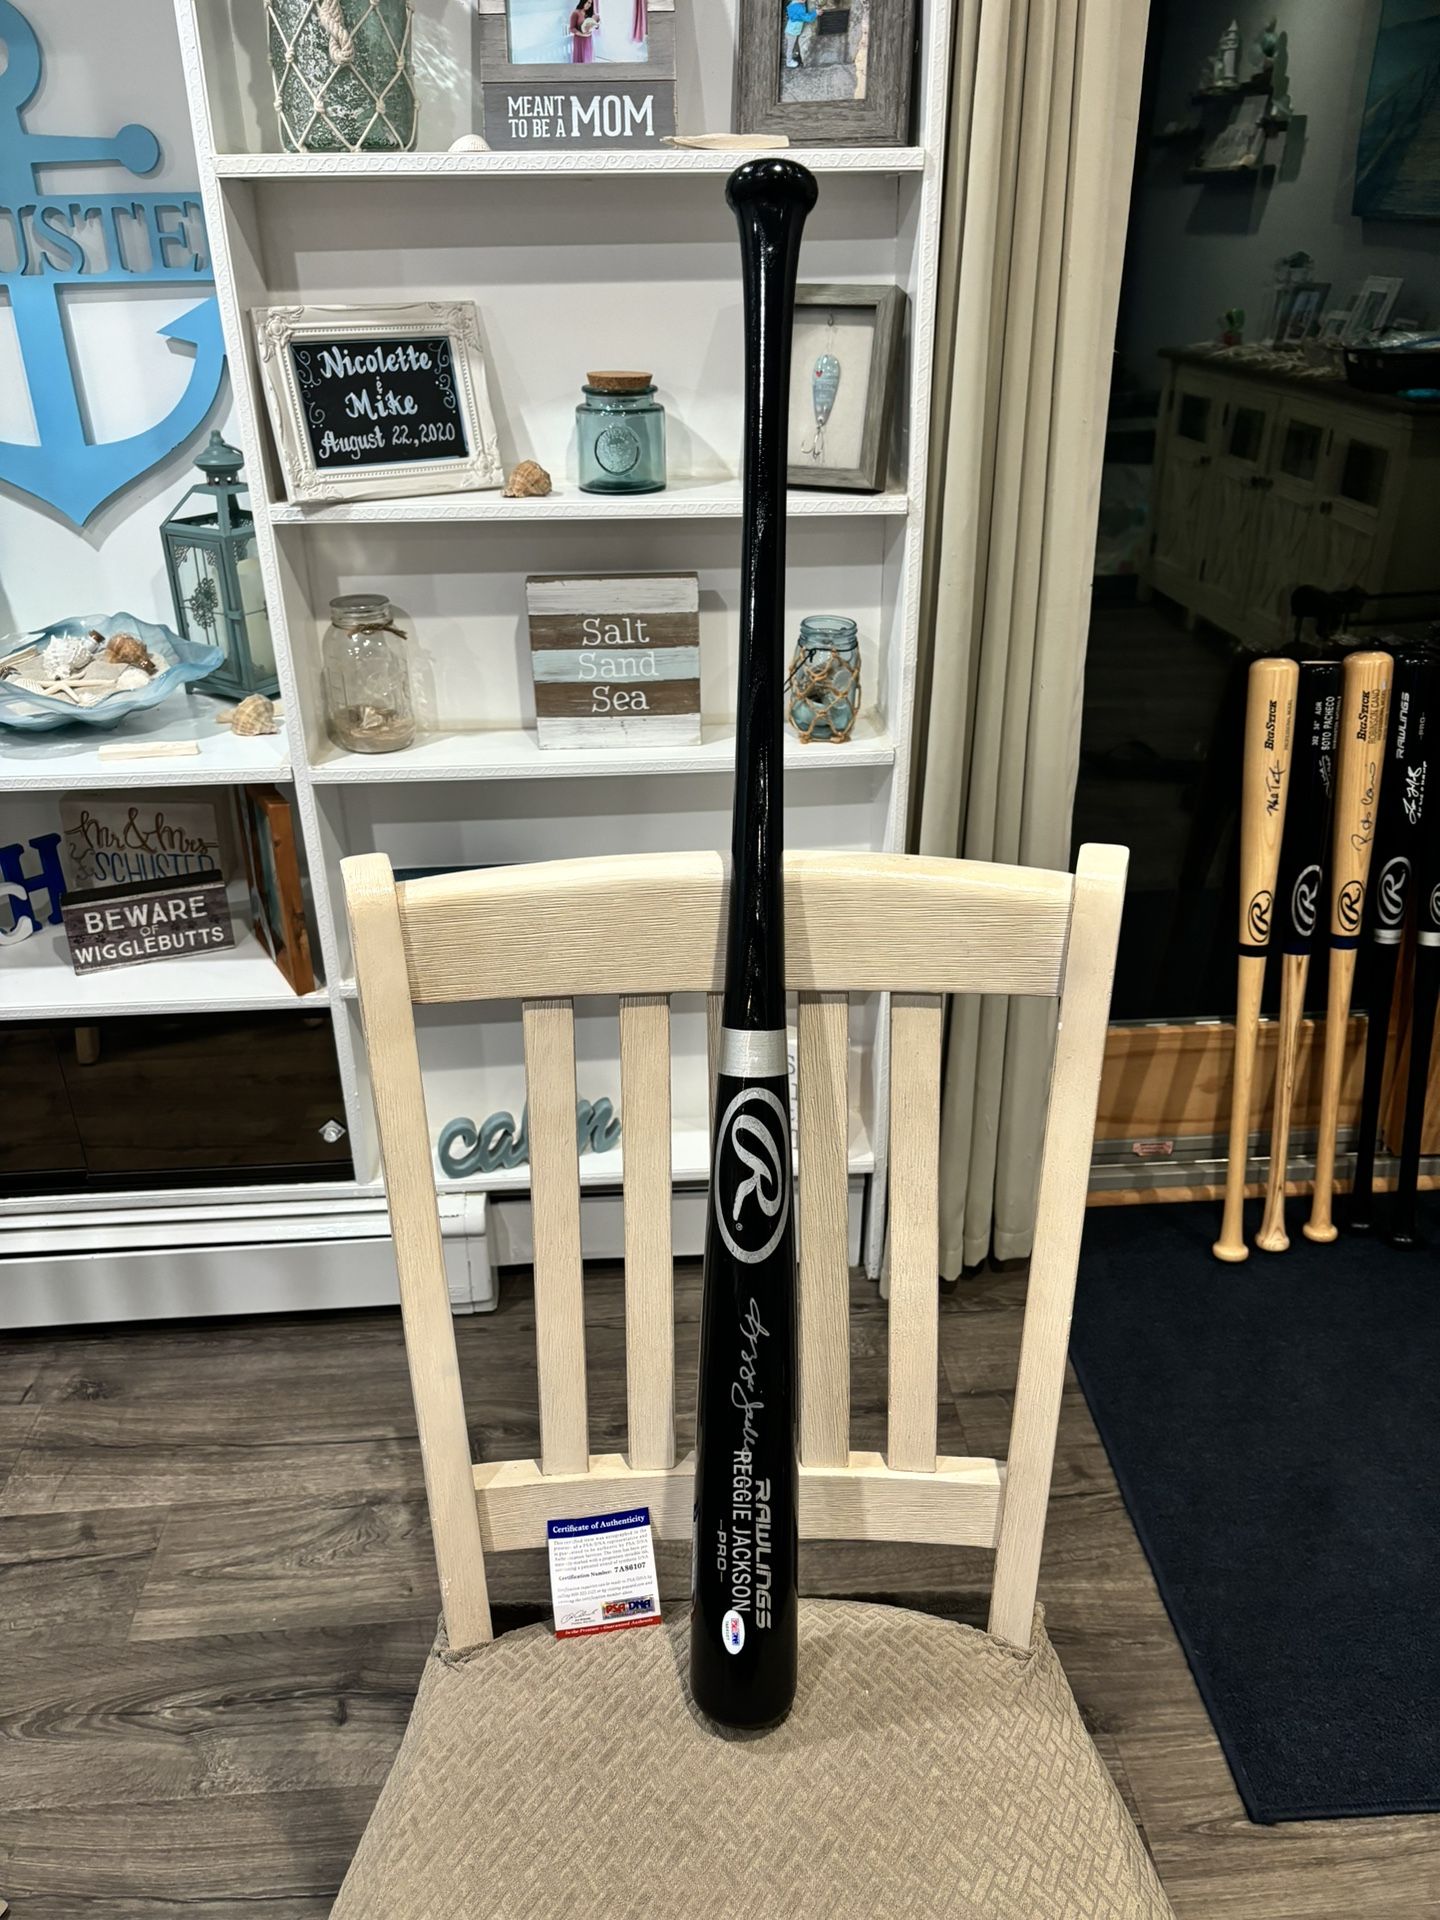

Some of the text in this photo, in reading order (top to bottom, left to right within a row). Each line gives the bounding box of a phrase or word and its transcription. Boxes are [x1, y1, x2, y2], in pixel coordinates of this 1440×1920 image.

[507, 95, 565, 117] MEANT
[569, 95, 655, 138] MOM
[508, 118, 567, 138] TO BE A
[317, 344, 432, 379] Nicolette
[344, 388, 418, 421] Mike
[318, 425, 386, 460] August
[582, 617, 650, 646] Salt
[578, 651, 659, 679] Sand
[591, 685, 650, 713] Sea
[1323, 696, 1335, 730] PACHECO
[1321, 731, 1331, 751] SOTO
[1396, 691, 1410, 759] RAWLINGS
[84, 895, 208, 935] BEWARE
[139, 924, 160, 938] OF
[74, 926, 225, 964] WIGGLEBUTTS
[732, 1450, 753, 1521] REGGIE
[552, 1514, 645, 1534] Certificate of Authenticity
[731, 1525, 752, 1612] JACKSON
[755, 1478, 772, 1629] RAWLINGS
[628, 1599, 651, 1611] DNA
